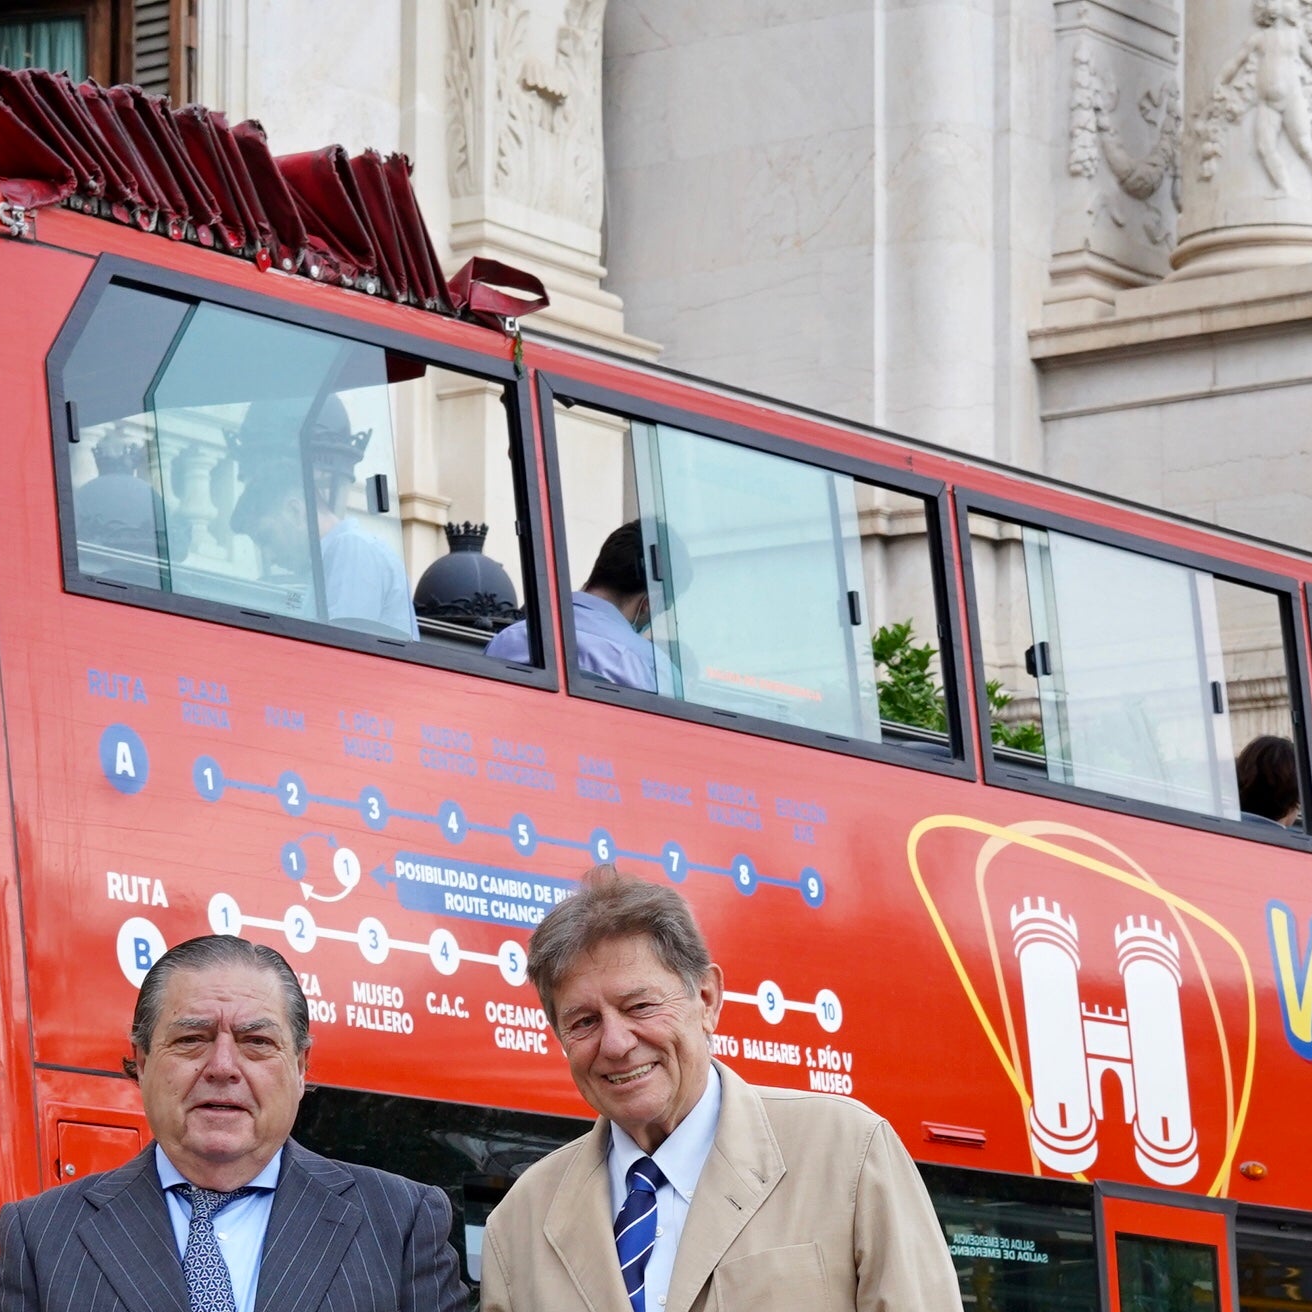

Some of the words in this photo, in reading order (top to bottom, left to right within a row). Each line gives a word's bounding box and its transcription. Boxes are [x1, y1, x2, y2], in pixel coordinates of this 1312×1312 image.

[86, 668, 149, 705] RUTA
[115, 741, 136, 778] A
[203, 767, 214, 790] 1
[287, 782, 300, 806] 2
[368, 796, 381, 820] 3
[447, 811, 459, 834] 4
[517, 824, 530, 847] 5
[597, 838, 609, 860] 6
[669, 850, 680, 872] 7
[739, 864, 751, 886] 8
[807, 877, 819, 898] 9
[289, 852, 298, 871] 1
[343, 858, 350, 876] 1
[107, 871, 169, 908] RUTA
[394, 860, 478, 891] POSIBILIDAD
[480, 875, 532, 901] CAMBIO
[534, 884, 552, 904] DE
[444, 892, 489, 917] ROUTE
[134, 937, 153, 971] B
[221, 907, 229, 928] 1
[294, 917, 306, 939] 2
[368, 929, 379, 950] 3
[439, 941, 449, 961] 4
[508, 952, 519, 972] 5
[766, 992, 776, 1011] 9
[821, 1001, 836, 1021] 10
[352, 981, 404, 1009] MUSEO
[426, 992, 470, 1018] C.A.C.
[346, 1005, 414, 1035] FALLERO
[494, 1026, 548, 1055] GRAFIC
[742, 1037, 801, 1066] BALEARES
[805, 1047, 817, 1068] S.
[818, 1044, 841, 1072] PÍO
[842, 1053, 853, 1072] V
[809, 1070, 853, 1095] MUSEO
